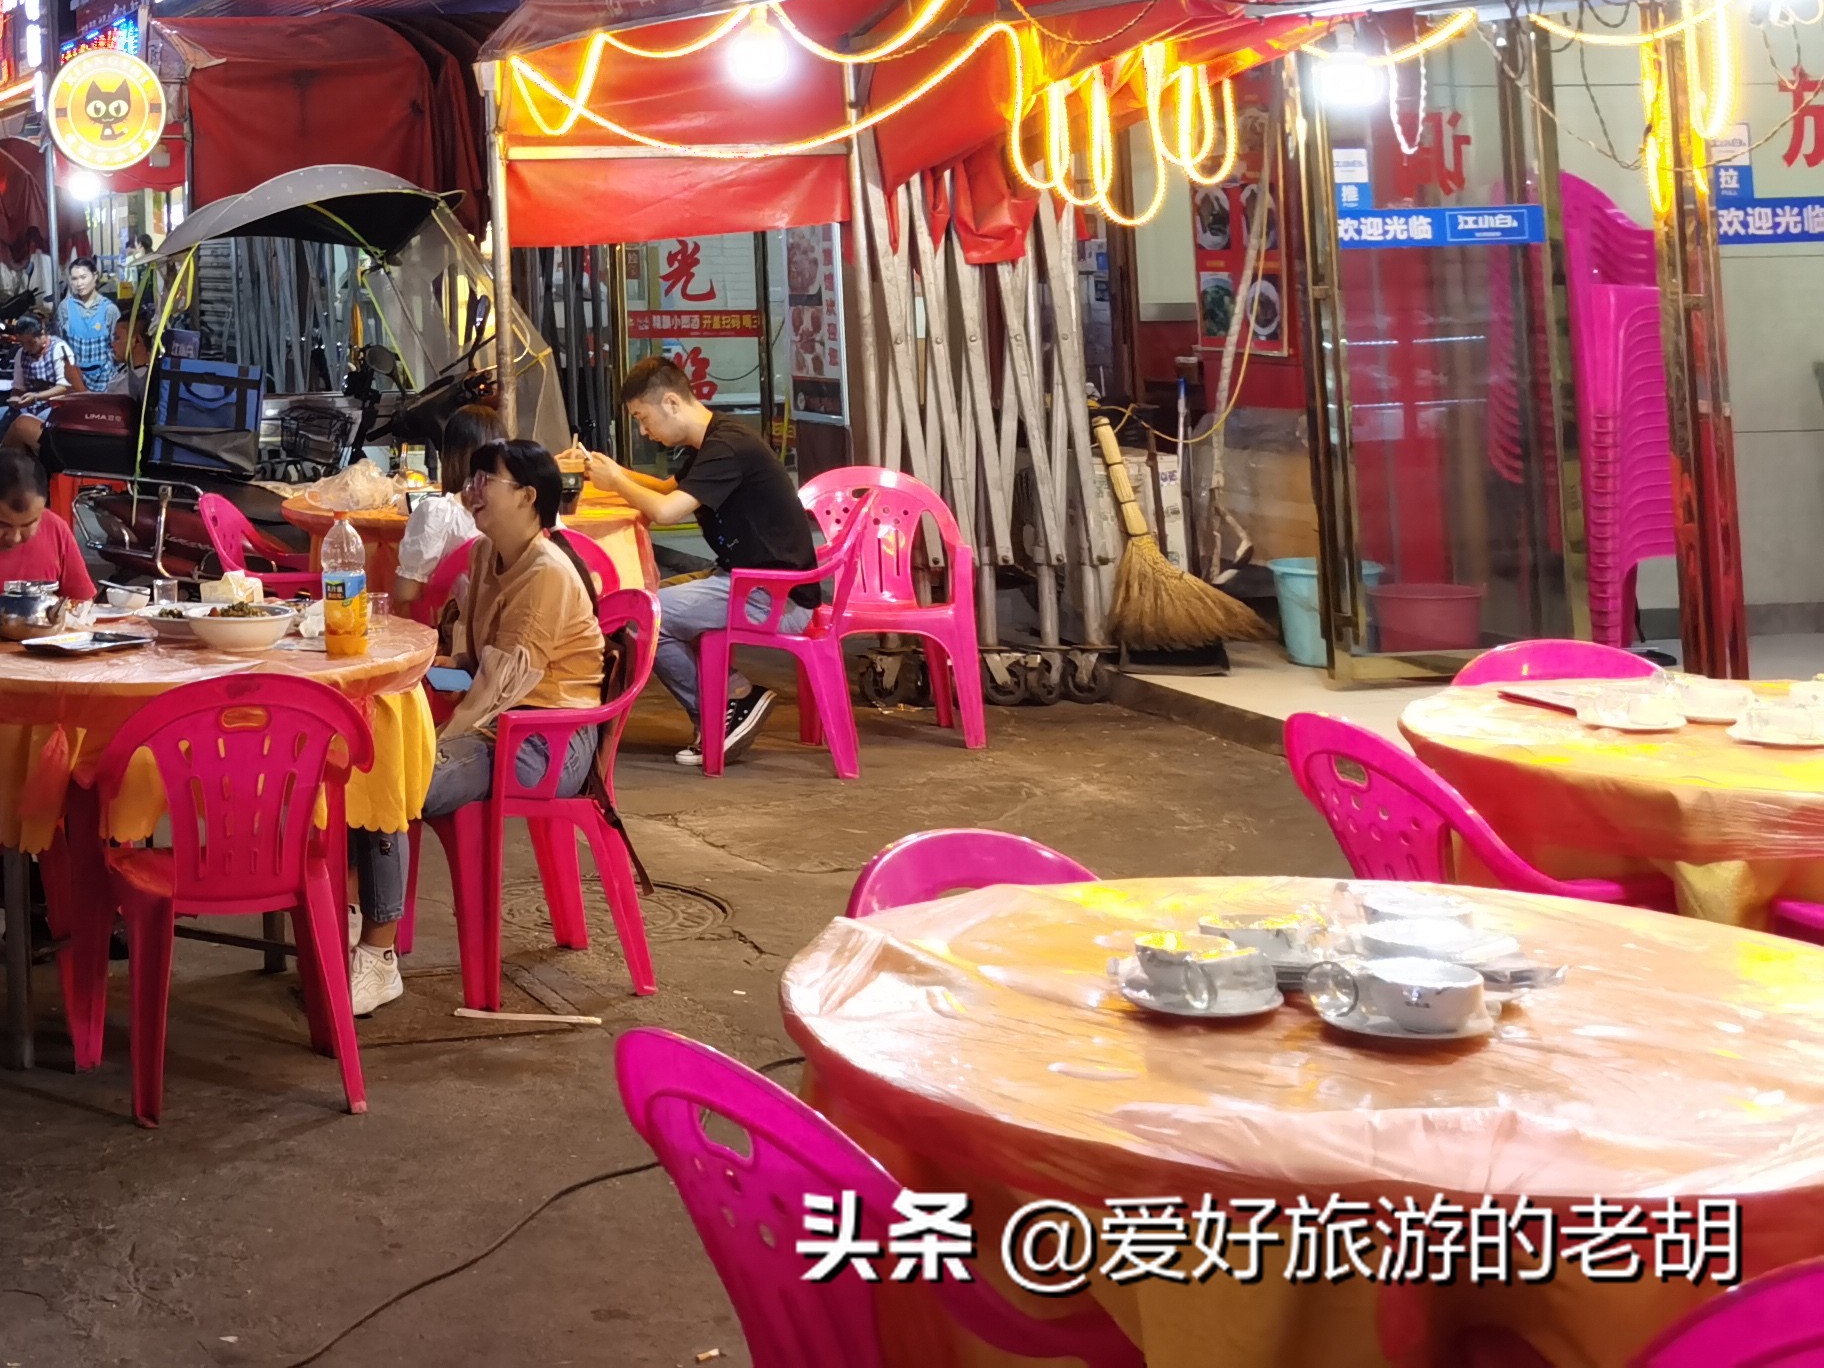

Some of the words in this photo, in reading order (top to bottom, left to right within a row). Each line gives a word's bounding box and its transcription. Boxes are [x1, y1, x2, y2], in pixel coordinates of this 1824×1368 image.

[1718, 168, 1740, 189] 拉
[1342, 185, 1359, 203] 推
[1337, 214, 1433, 242] 欢迎光临
[1457, 213, 1518, 230] 江小白
[1718, 204, 1824, 237] 欢迎光临
